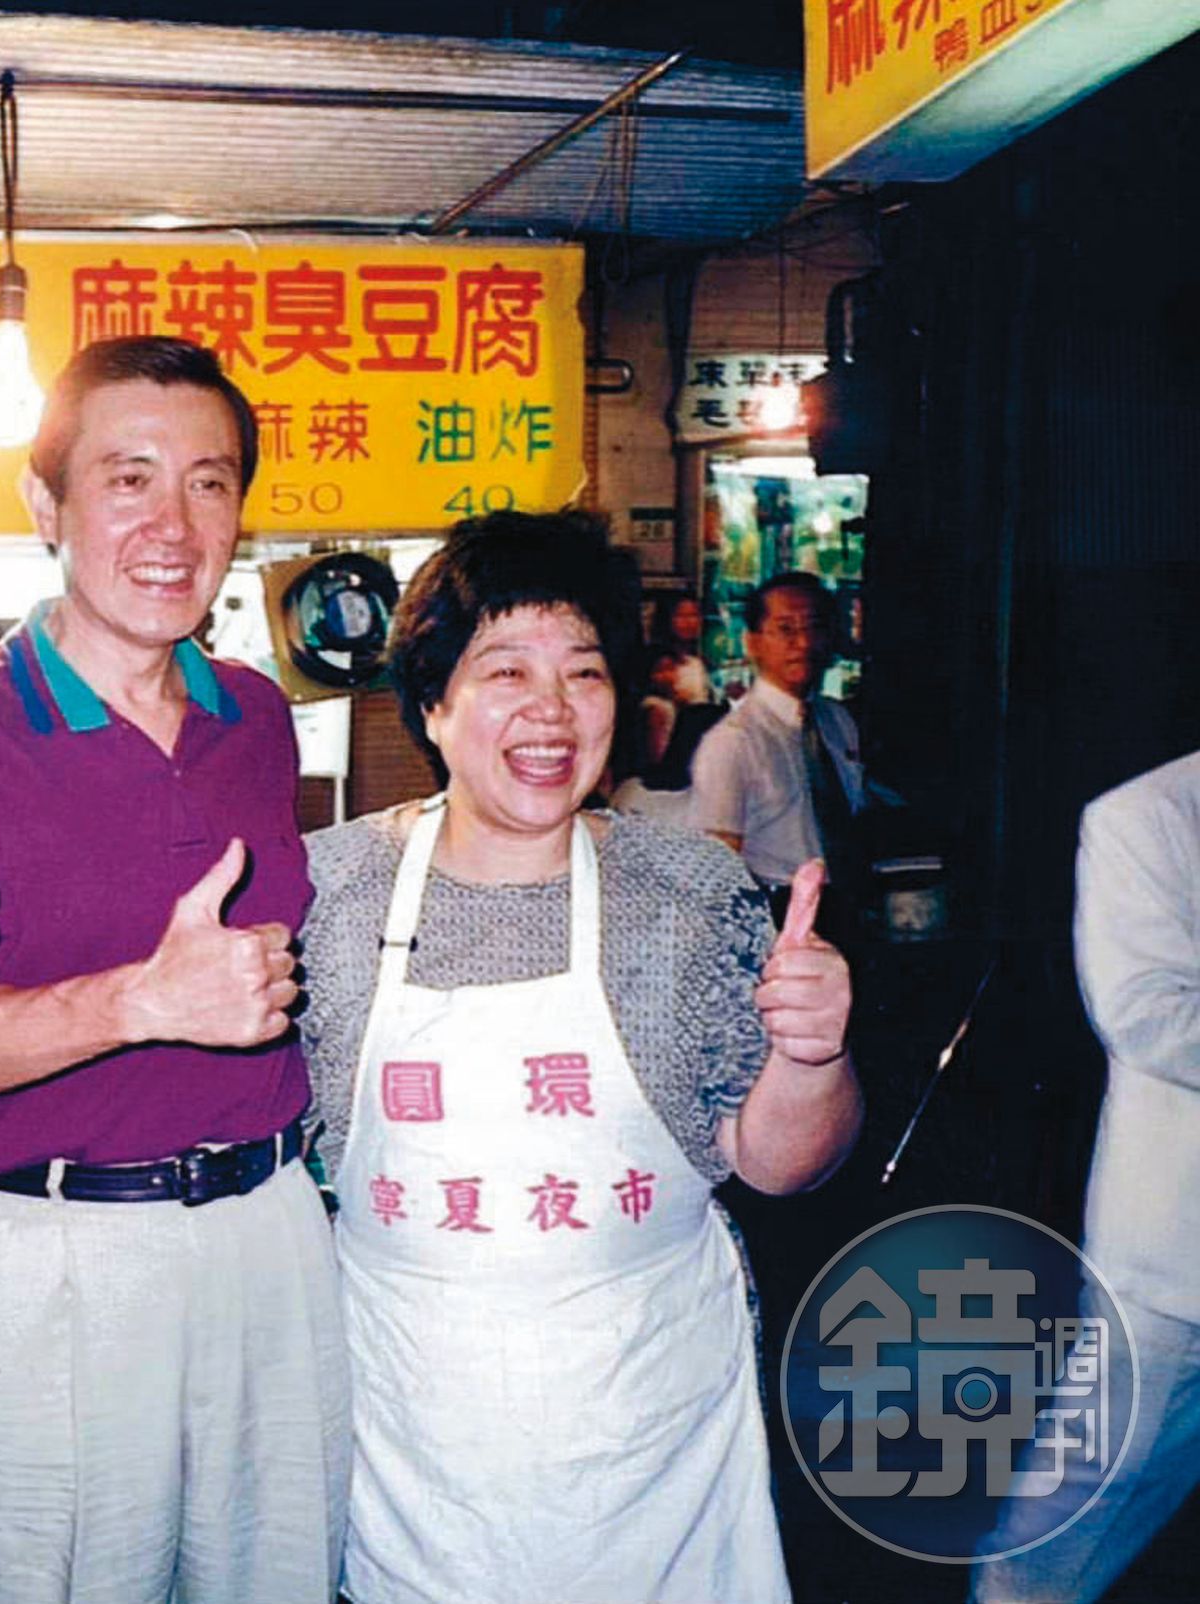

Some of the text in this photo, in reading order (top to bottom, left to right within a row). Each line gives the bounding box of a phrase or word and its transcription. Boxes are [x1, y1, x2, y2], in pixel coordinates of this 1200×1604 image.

[933, 0, 1046, 73] 鴨血
[71, 258, 545, 378] 麻辣臭豆腐
[252, 398, 553, 464] 麻辣 油炸
[269, 481, 516, 517] 50 40
[381, 1052, 596, 1122] 圓環
